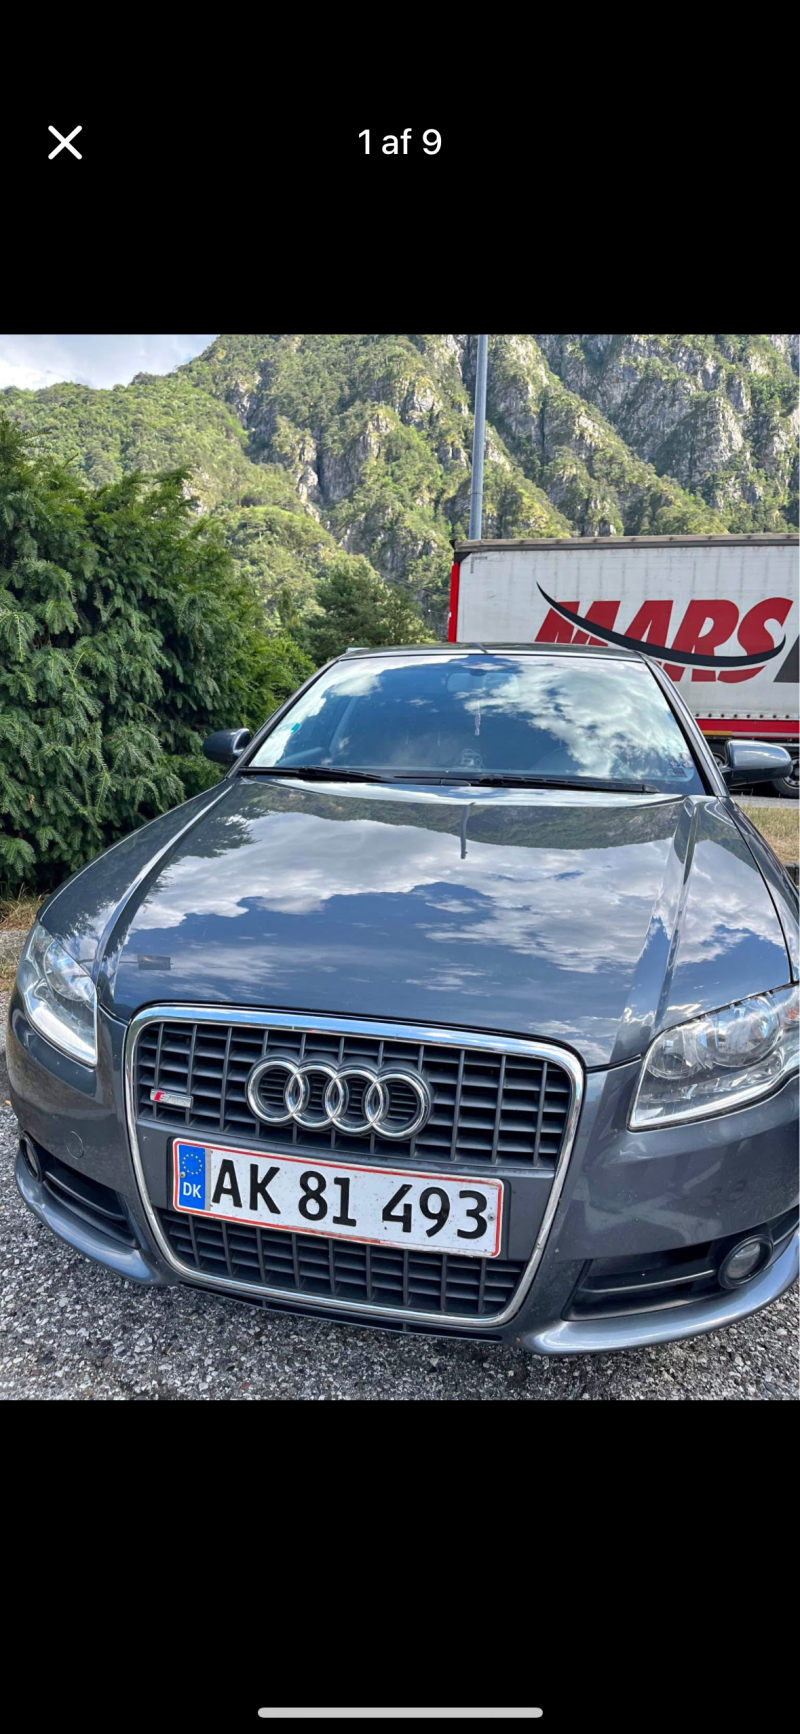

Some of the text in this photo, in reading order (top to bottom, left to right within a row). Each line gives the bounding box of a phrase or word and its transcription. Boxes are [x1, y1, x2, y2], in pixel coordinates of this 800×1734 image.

[182, 1181, 202, 1199] DK
[211, 1158, 489, 1240] AK 81 493
